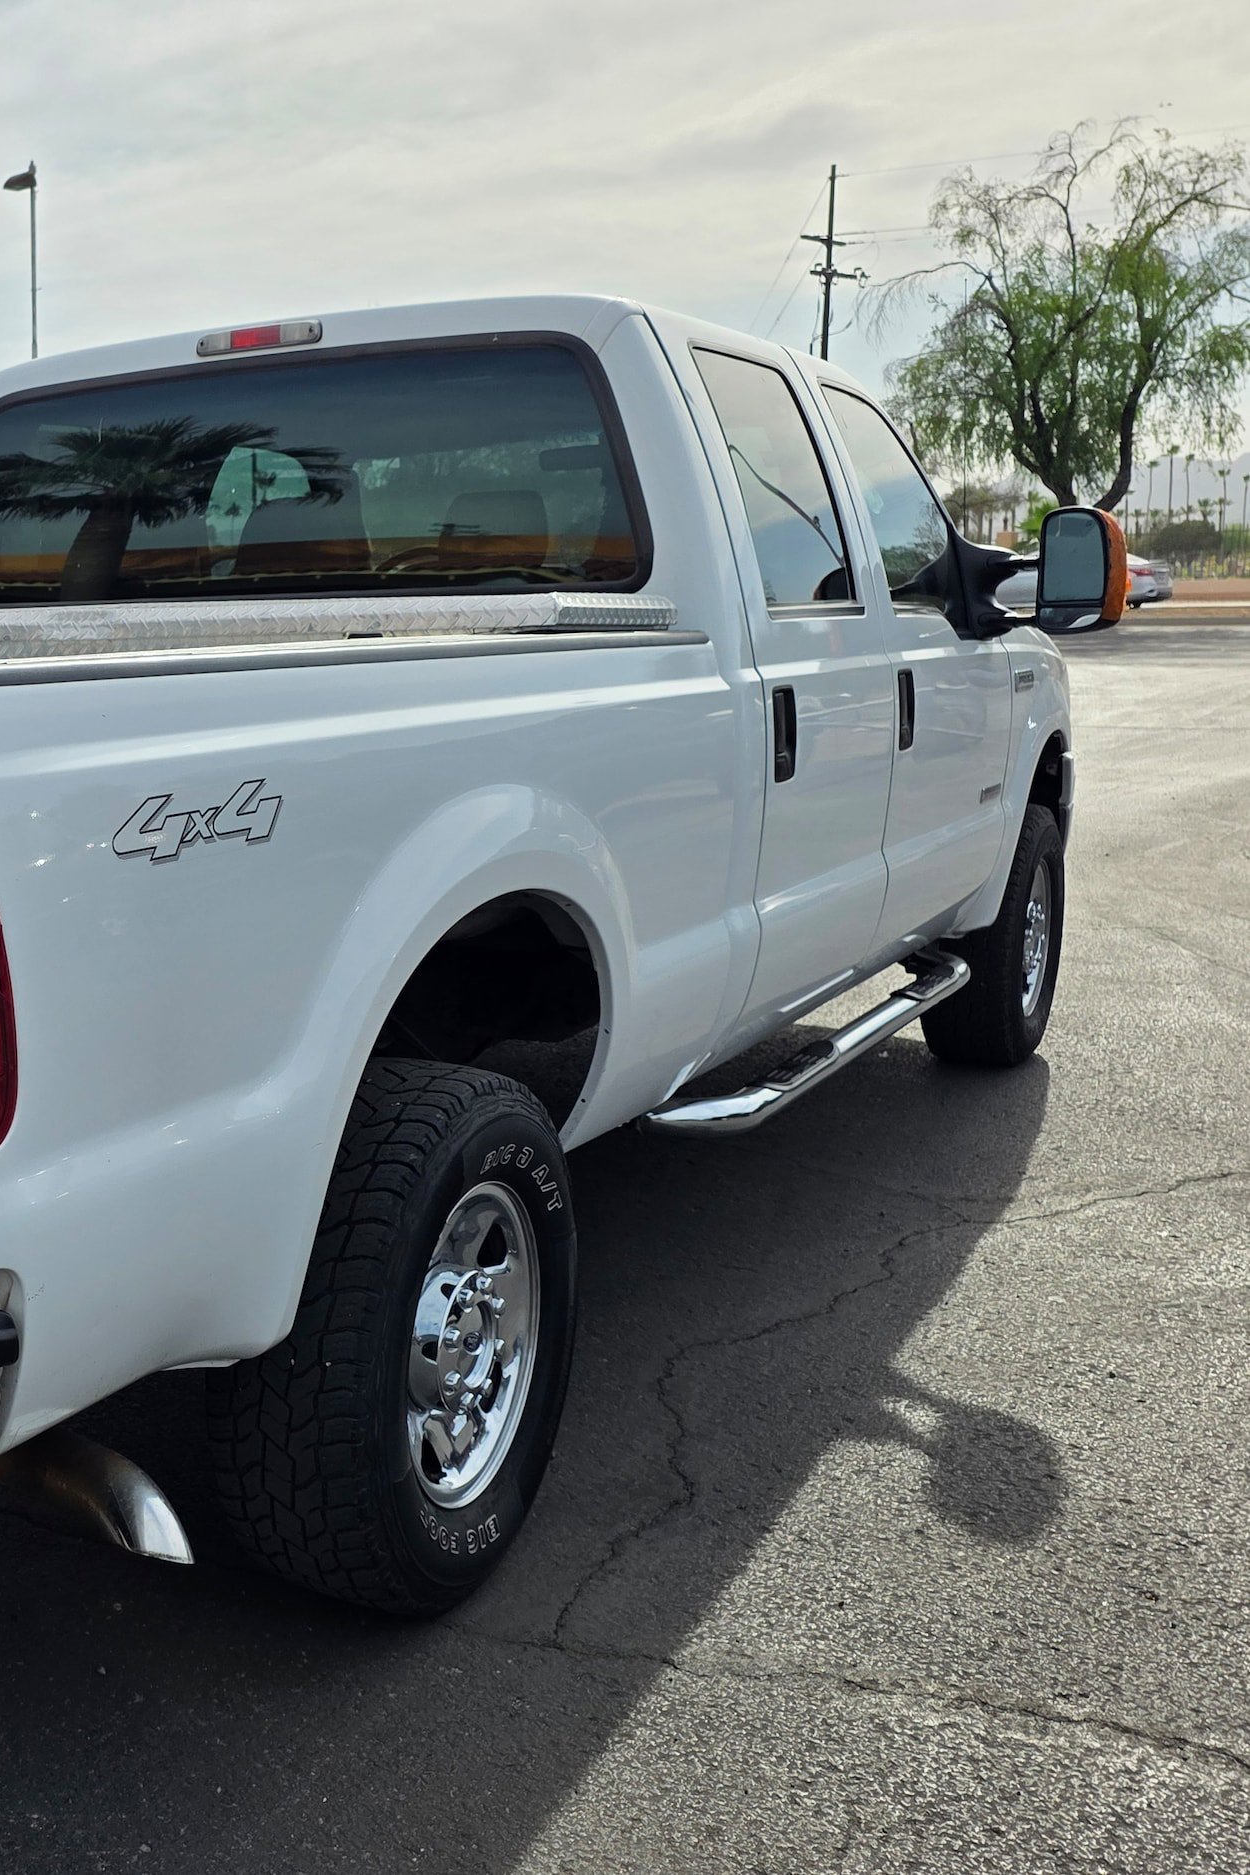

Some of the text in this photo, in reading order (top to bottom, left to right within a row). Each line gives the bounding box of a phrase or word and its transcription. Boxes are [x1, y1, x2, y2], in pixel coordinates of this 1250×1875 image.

[112, 778, 284, 865] 4x4
[531, 1164, 563, 1212] A/T
[466, 1513, 501, 1555] BIG
